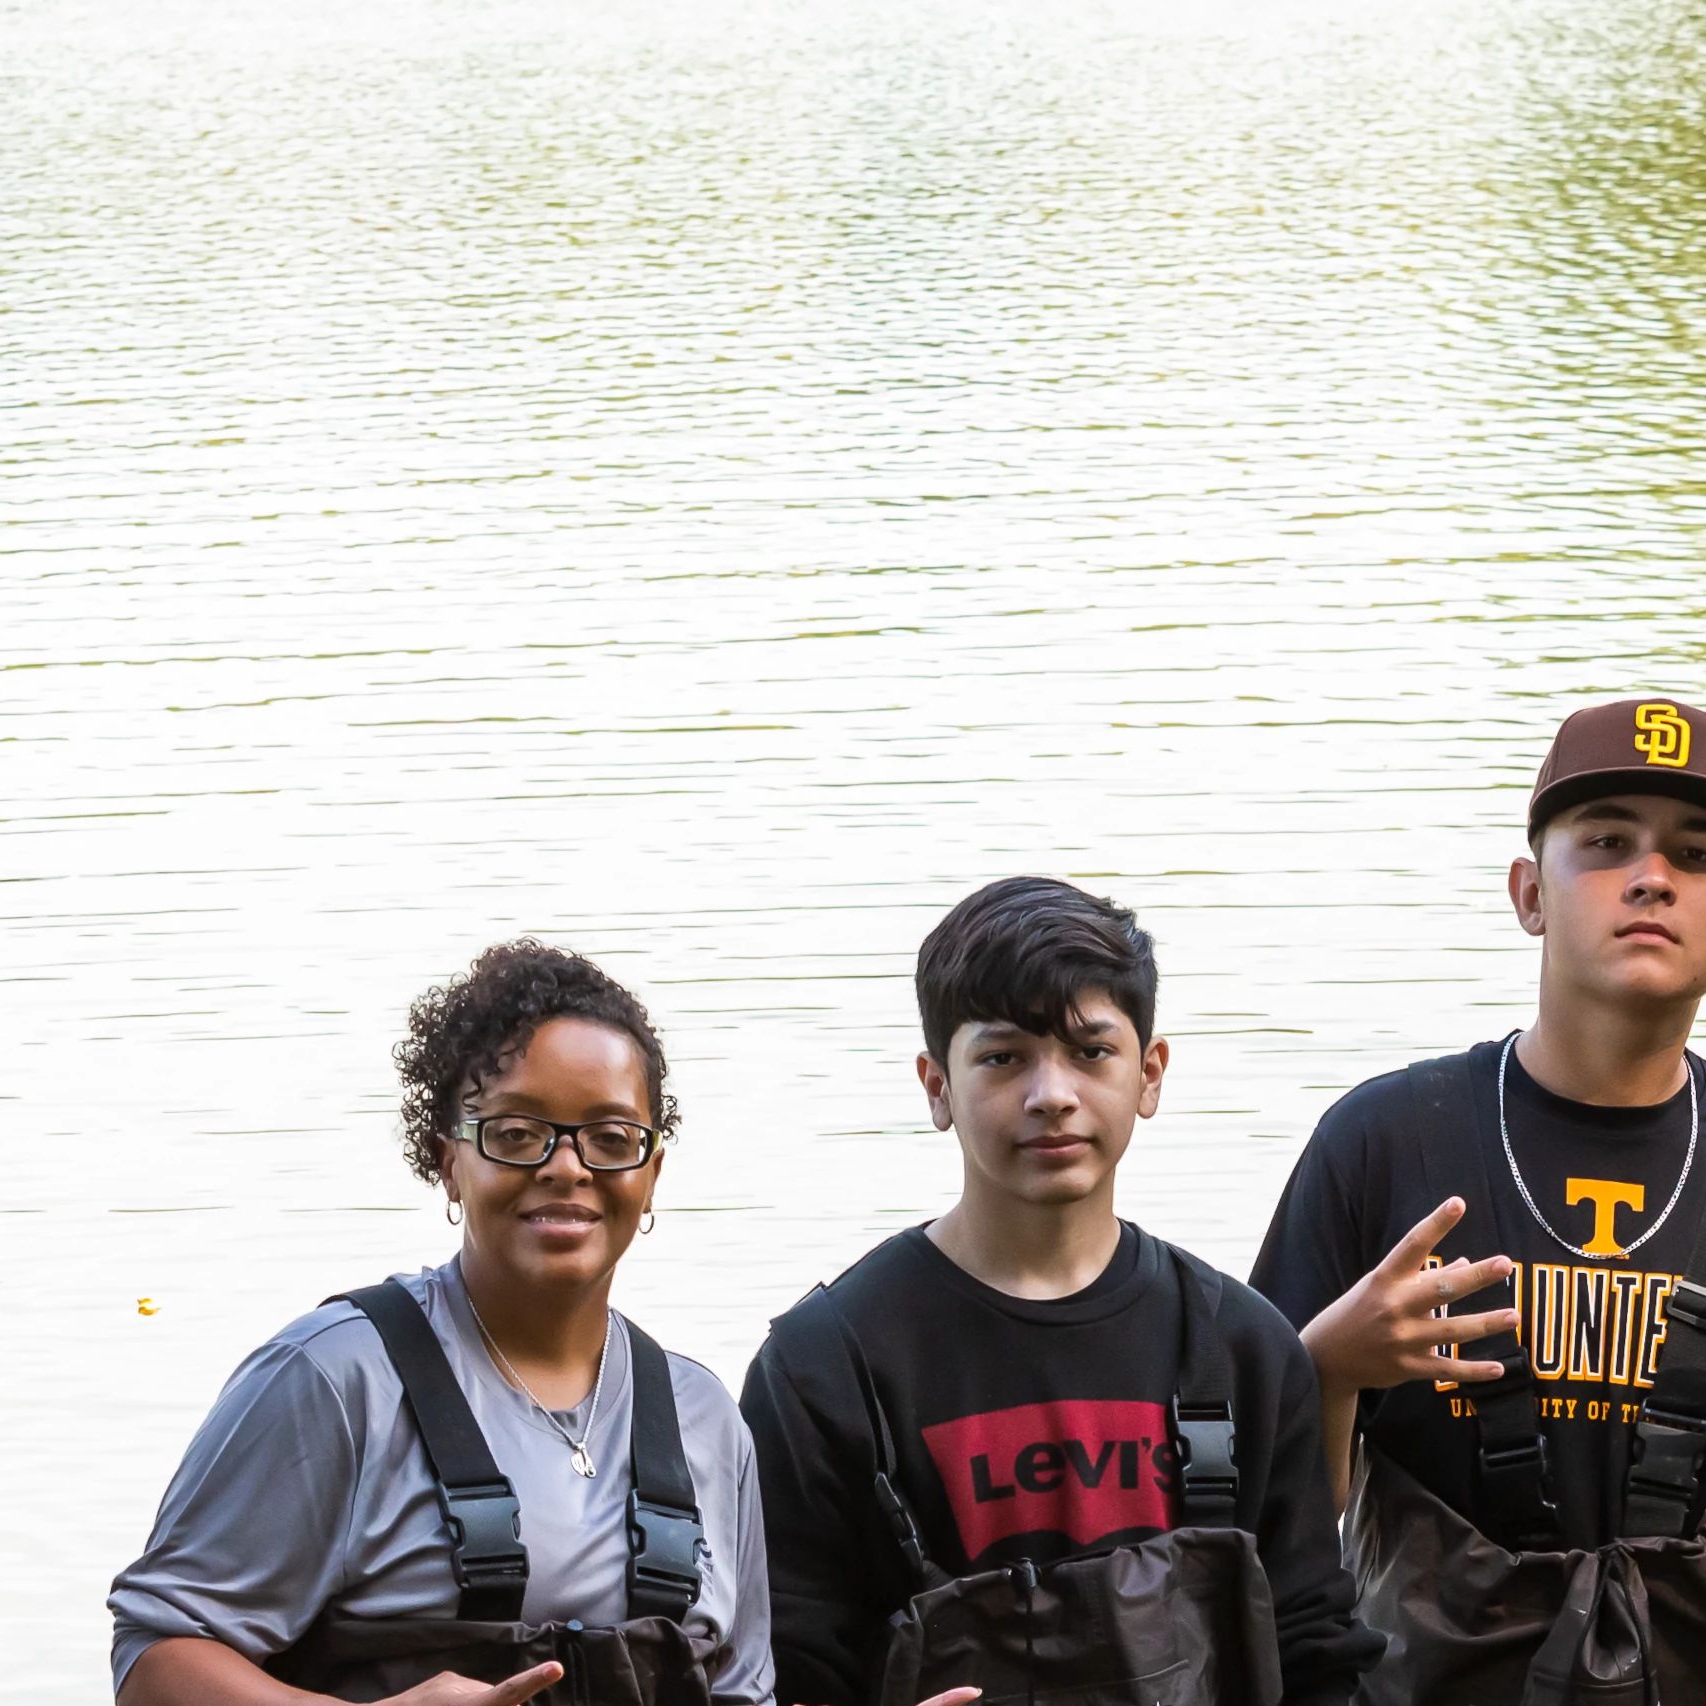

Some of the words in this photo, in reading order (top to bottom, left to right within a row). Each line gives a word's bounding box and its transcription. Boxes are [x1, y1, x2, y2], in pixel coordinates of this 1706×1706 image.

[1635, 704, 1691, 768] SD
[1565, 1177, 1645, 1260] T
[1587, 1400, 1611, 1422] OF
